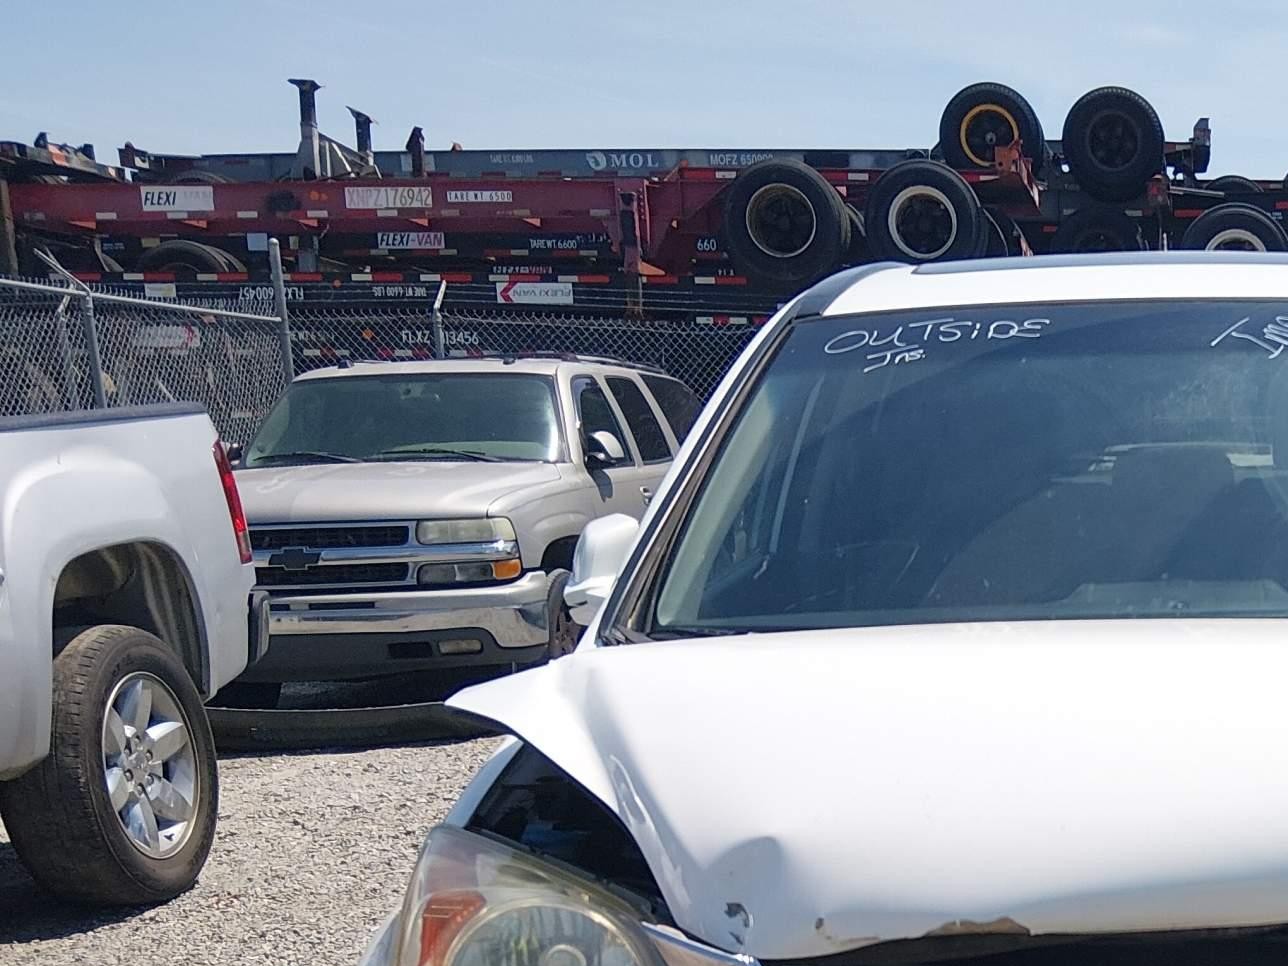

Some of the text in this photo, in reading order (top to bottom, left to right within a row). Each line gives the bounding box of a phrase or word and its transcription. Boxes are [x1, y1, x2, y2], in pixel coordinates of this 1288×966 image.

[610, 153, 659, 168] MOL
[709, 154, 738, 165] MOFZ
[143, 191, 177, 206] FLEXI
[489, 191, 512, 201] 6500
[379, 234, 443, 247] FLEXI-VAN
[824, 317, 1050, 354] OUTSIDE
